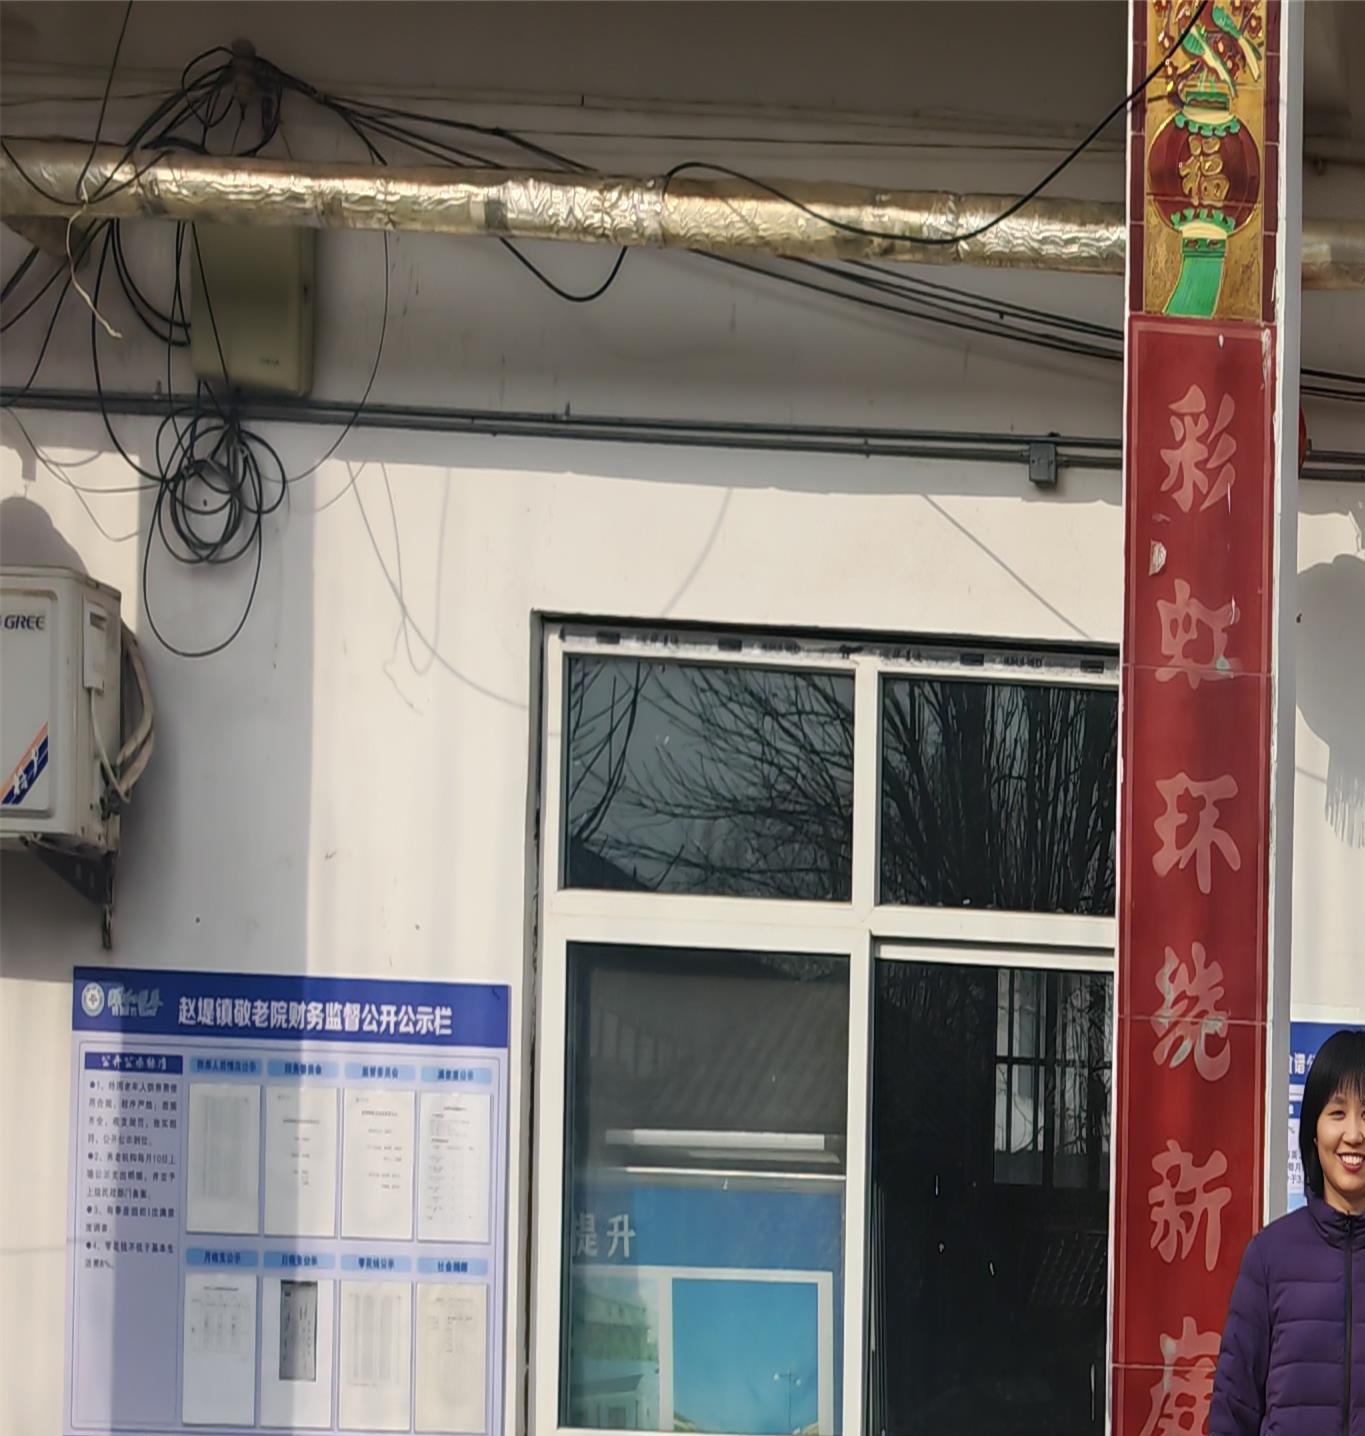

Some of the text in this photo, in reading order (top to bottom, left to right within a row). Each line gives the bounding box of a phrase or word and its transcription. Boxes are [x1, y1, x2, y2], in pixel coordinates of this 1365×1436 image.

[3, 614, 46, 631] GREE
[178, 995, 453, 1036] 赵堤镇敬老院财务监督公开公示栏
